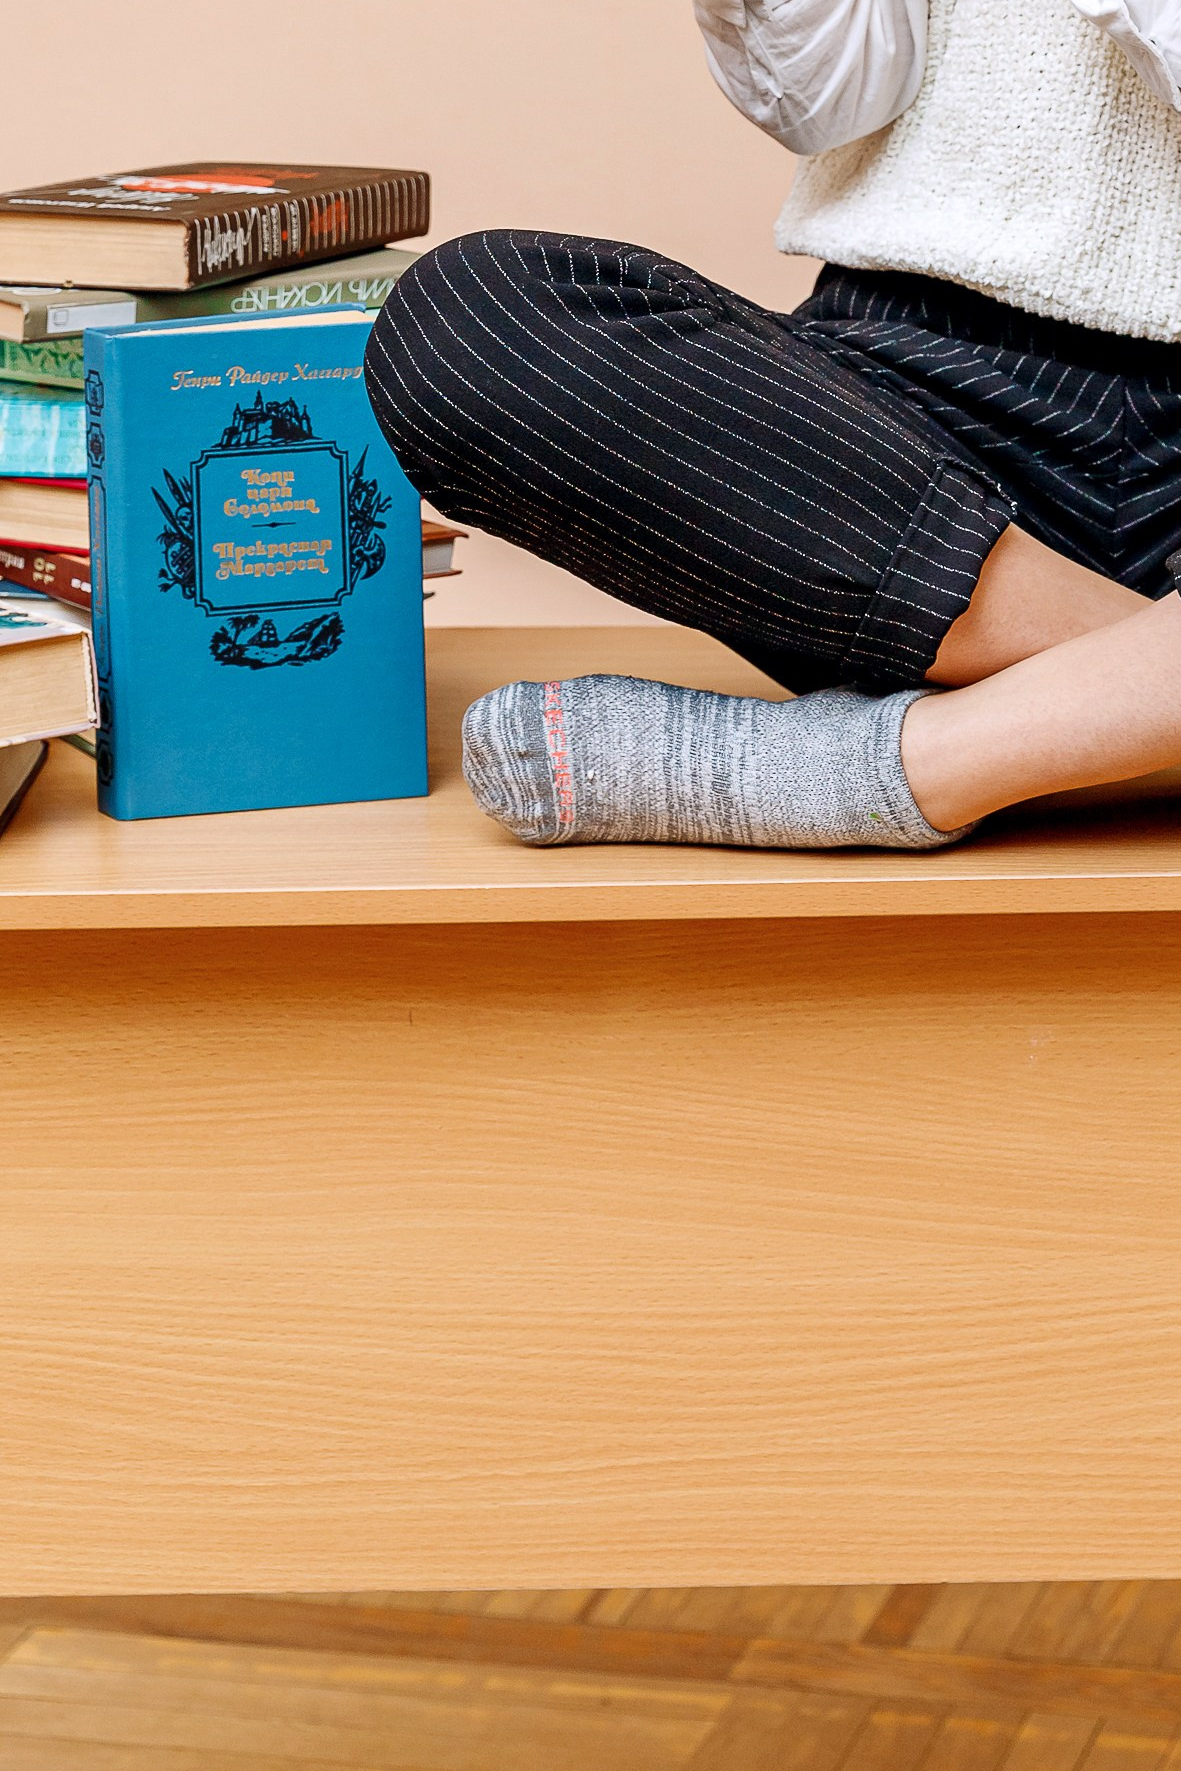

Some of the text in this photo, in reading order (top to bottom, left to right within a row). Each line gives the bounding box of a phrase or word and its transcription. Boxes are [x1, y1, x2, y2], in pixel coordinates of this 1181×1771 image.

[171, 363, 365, 391] Генри Райдер Хаггард
[240, 468, 295, 487] Копи
[246, 486, 293, 500] царя
[223, 498, 320, 519] Соломона
[212, 538, 333, 560] Прекрасная
[215, 557, 330, 581] Маргарет
